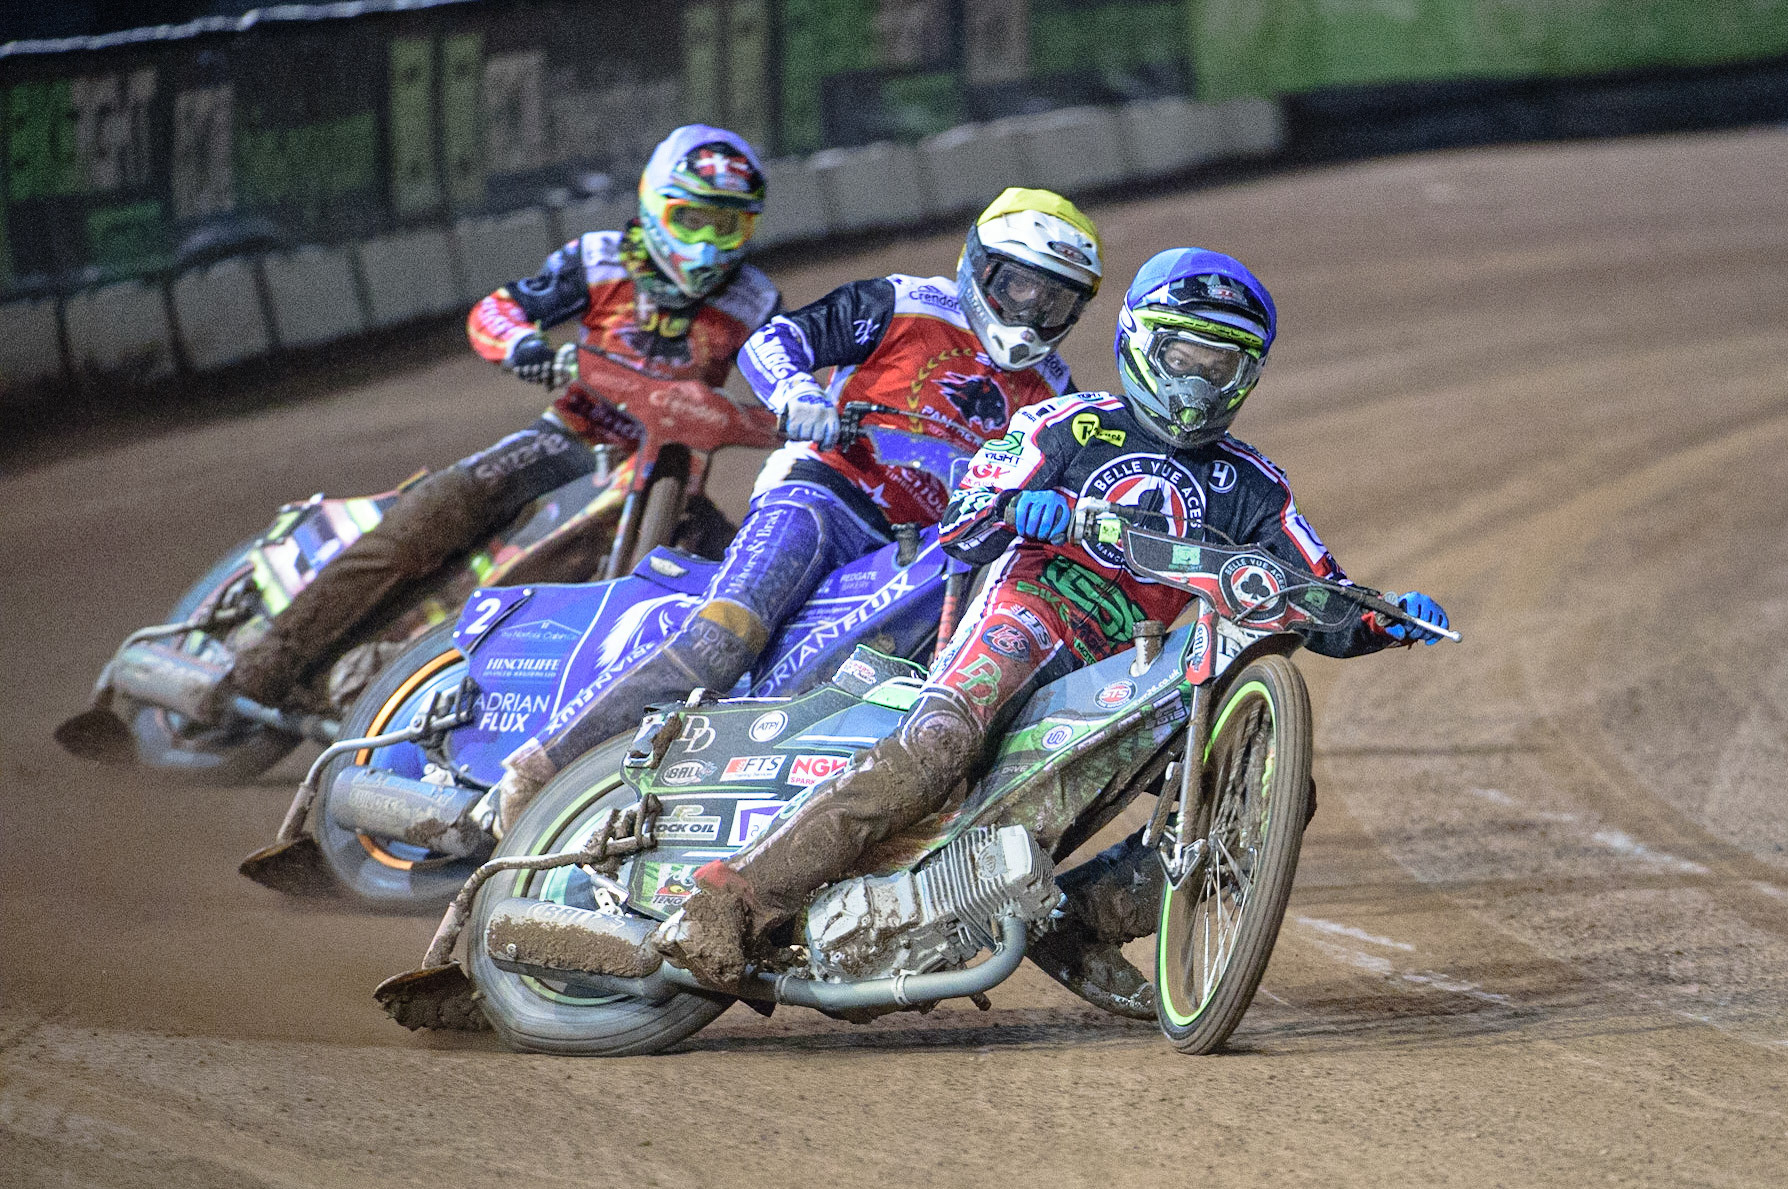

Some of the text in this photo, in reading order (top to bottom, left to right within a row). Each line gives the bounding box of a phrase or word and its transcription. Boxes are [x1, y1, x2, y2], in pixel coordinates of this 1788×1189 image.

[1093, 460, 1202, 529] BELLE VUE ACES
[1224, 558, 1247, 576] BELLE
[1249, 558, 1269, 570] VUE
[464, 597, 501, 635] 2
[486, 658, 560, 671] HINCHLIFFE
[473, 692, 551, 713] ADRIAN
[478, 711, 530, 733] FLUX
[743, 756, 782, 771] FTS
[655, 823, 715, 834] OCK OIL
